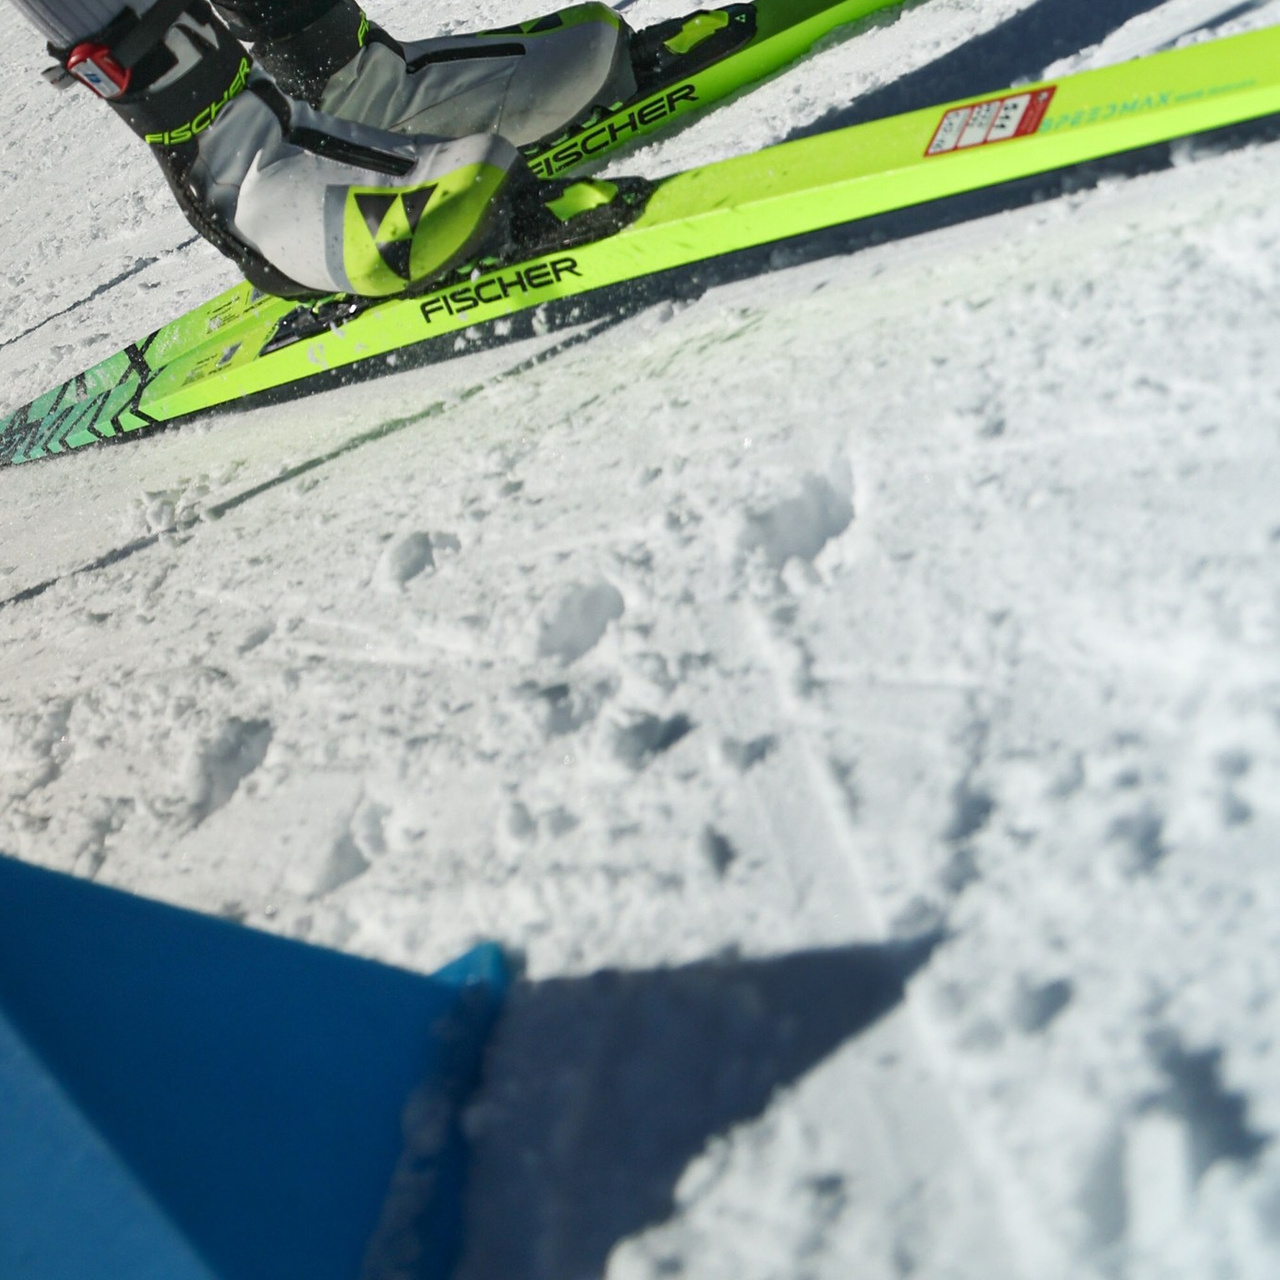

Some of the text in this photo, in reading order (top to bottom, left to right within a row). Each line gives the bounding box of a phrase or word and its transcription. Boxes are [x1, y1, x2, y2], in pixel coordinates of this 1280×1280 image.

[145, 57, 250, 145] FISCHER
[527, 83, 699, 177] FISCHER
[419, 256, 582, 324] FISCHER
